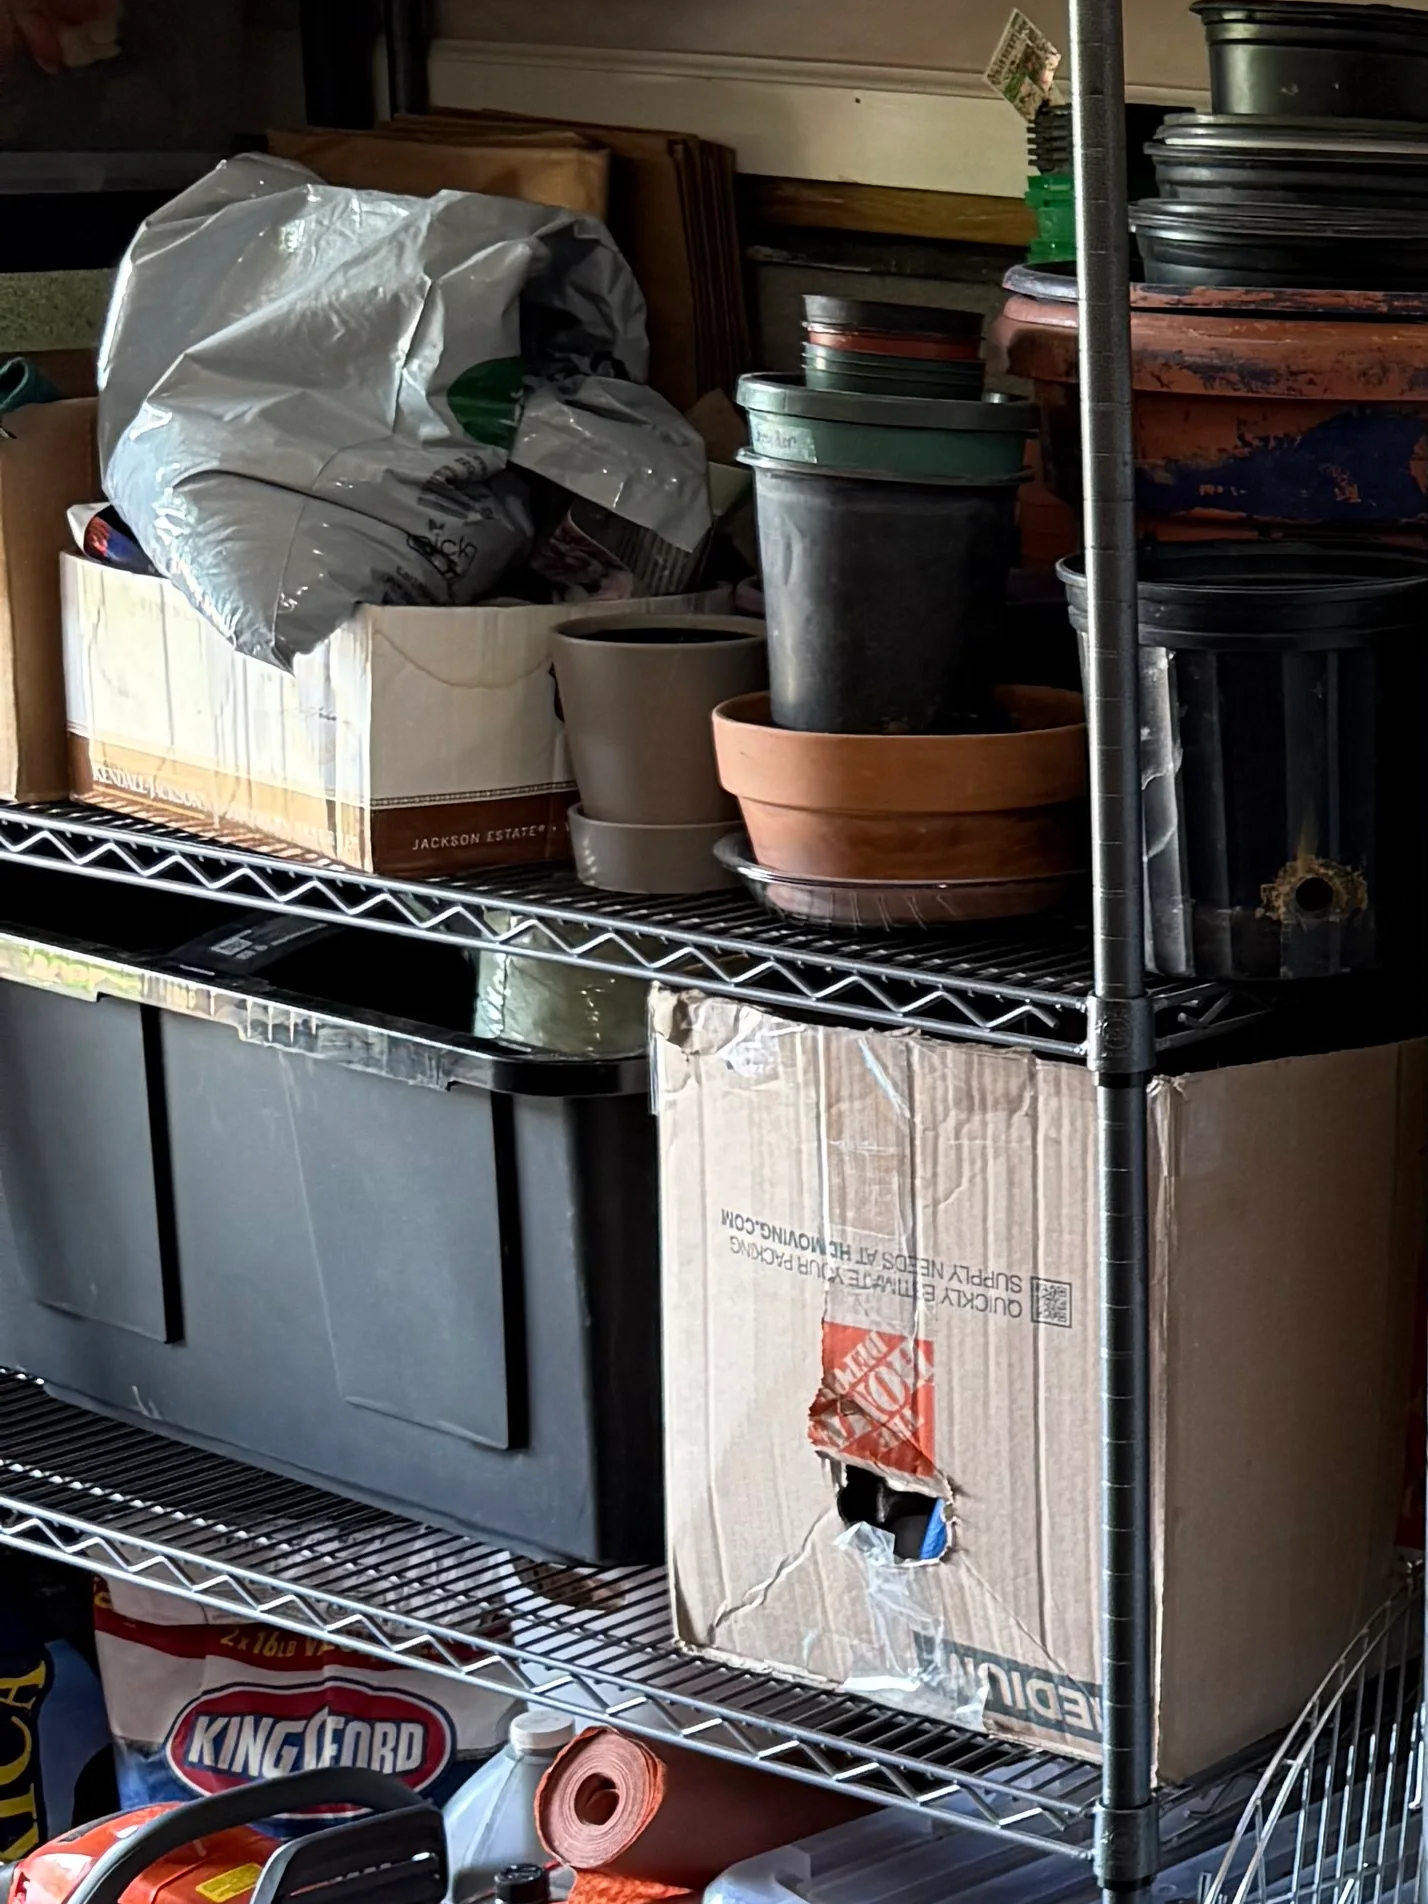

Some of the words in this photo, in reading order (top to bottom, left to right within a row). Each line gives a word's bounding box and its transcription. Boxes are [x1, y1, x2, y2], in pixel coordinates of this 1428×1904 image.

[412, 832, 481, 851] JACKSON
[729, 1236, 794, 1271] PACKING
[857, 1247, 878, 1266] AT
[881, 1252, 944, 1281] NEEDS
[949, 1264, 1023, 1293] SUPPLY
[940, 1287, 1022, 1318] QUICKLY
[220, 1628, 235, 1646] 2
[253, 1631, 296, 1658] 16LB
[188, 1706, 425, 1780] KINGSFORD
